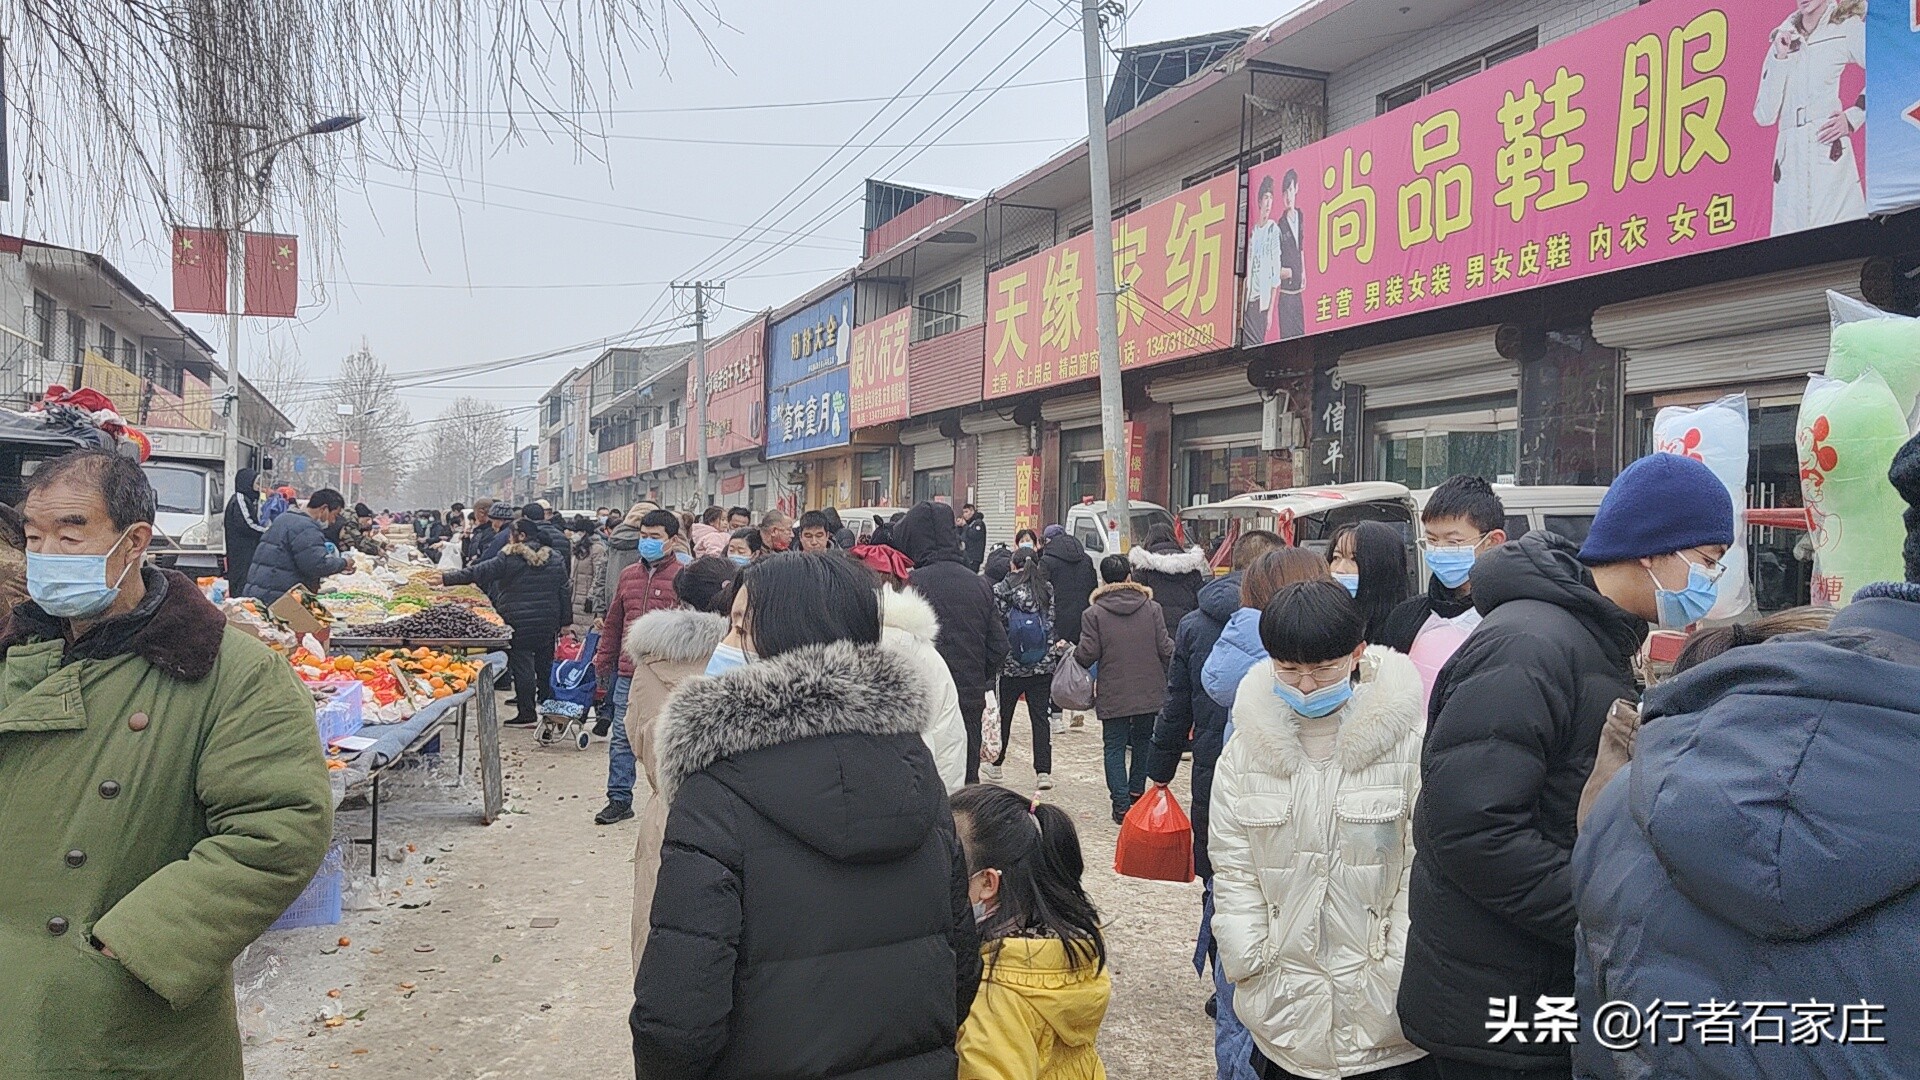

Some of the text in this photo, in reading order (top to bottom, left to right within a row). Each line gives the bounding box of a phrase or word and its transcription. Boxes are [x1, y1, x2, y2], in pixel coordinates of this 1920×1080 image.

[1317, 9, 1731, 274] 尚品鞋服
[992, 189, 1226, 368] 天缘家纺
[1315, 193, 1737, 323] 主营 男装女装 男女皮鞋 内衣 女包
[852, 312, 909, 391] 暖心布艺
[1058, 348, 1100, 379] 精品窗帘
